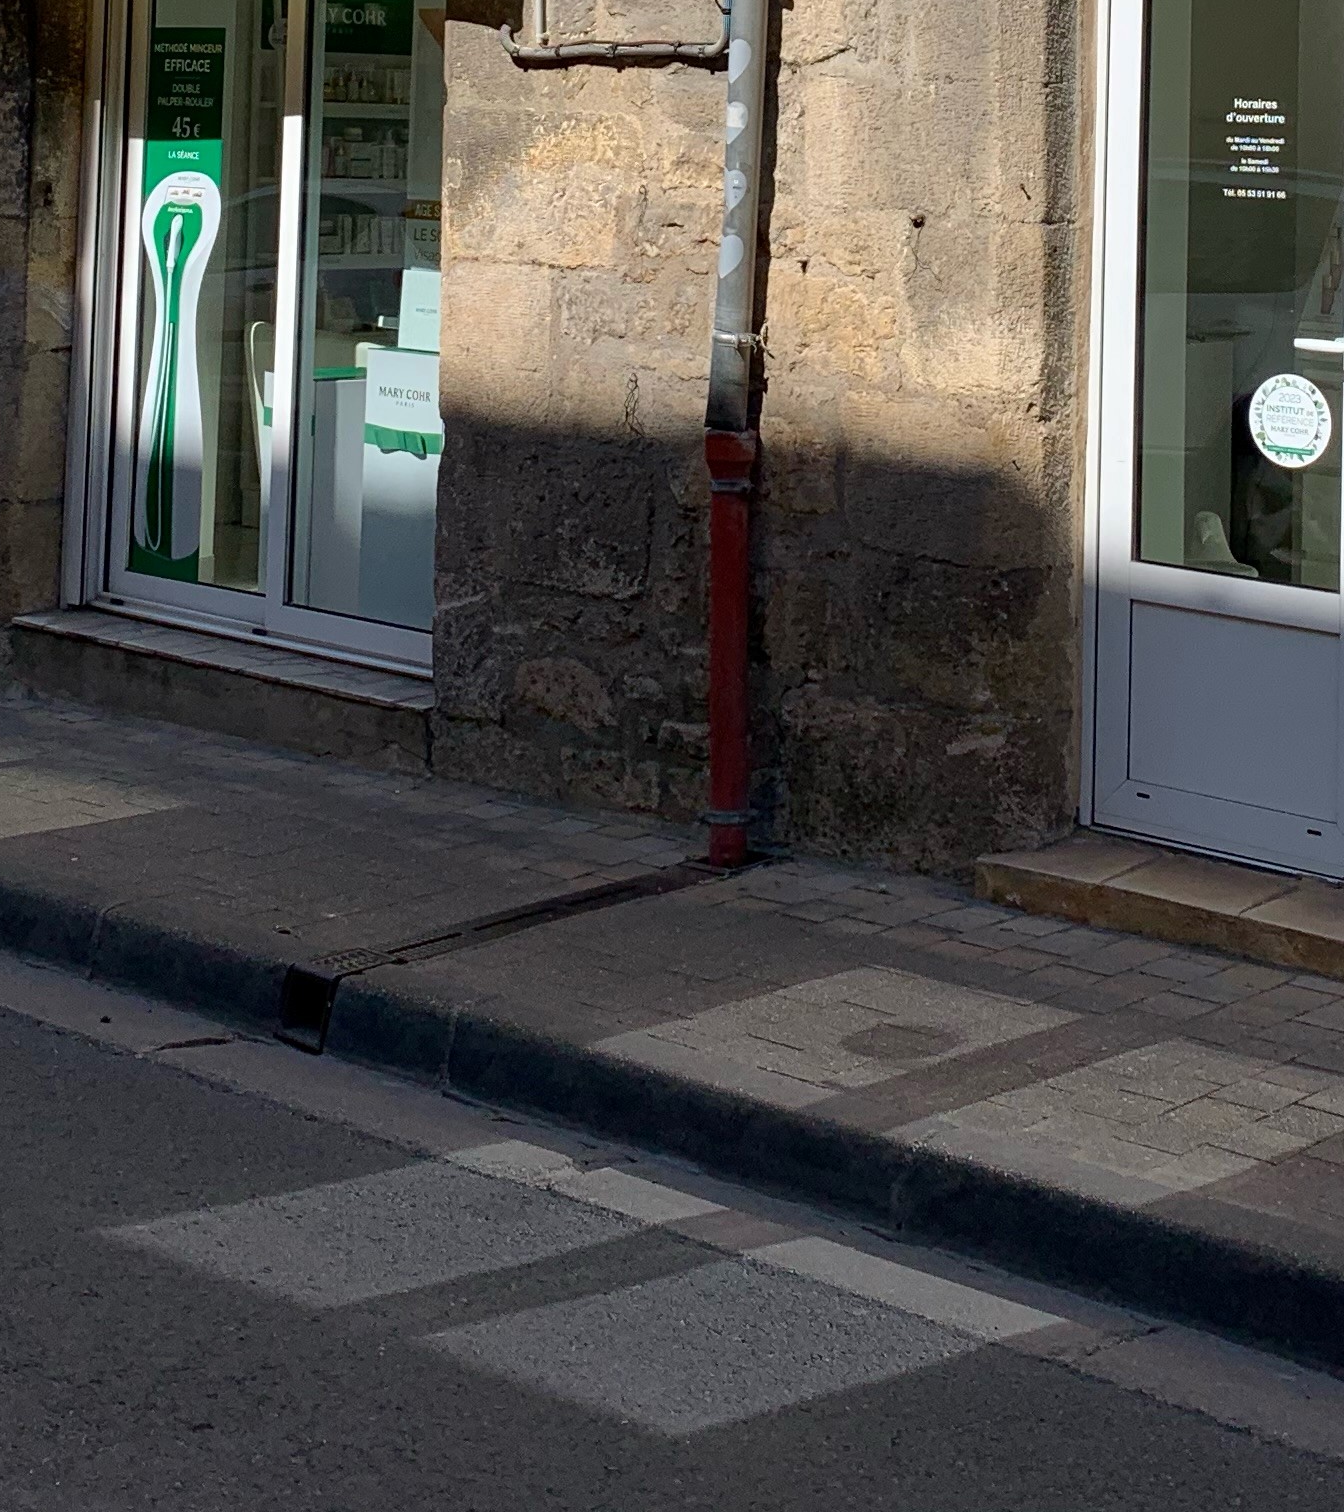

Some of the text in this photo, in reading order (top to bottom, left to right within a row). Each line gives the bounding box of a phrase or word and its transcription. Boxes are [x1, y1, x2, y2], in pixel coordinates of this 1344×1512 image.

[341, 9, 387, 26] COHR
[154, 43, 223, 53] MÉTHODE MINCEUR
[164, 59, 211, 72] EFFICACE
[172, 84, 200, 94] DOUBLE
[1234, 98, 1278, 109] Horaires
[171, 116, 191, 138] 45
[167, 149, 200, 160] LA SÉANCE
[1222, 188, 1236, 197] Tél.
[1237, 188, 1246, 197] 05
[1247, 189, 1256, 198] 53
[414, 203, 433, 217] AGE
[413, 228, 427, 241] LE
[414, 249, 441, 262] Visag
[379, 386, 431, 402] MARY COHR
[1278, 393, 1301, 404] 2023
[395, 400, 415, 408] PARIS
[1266, 405, 1305, 416] INSTITUT
[1270, 425, 1289, 433] MARY
[1290, 427, 1309, 436] COHR
